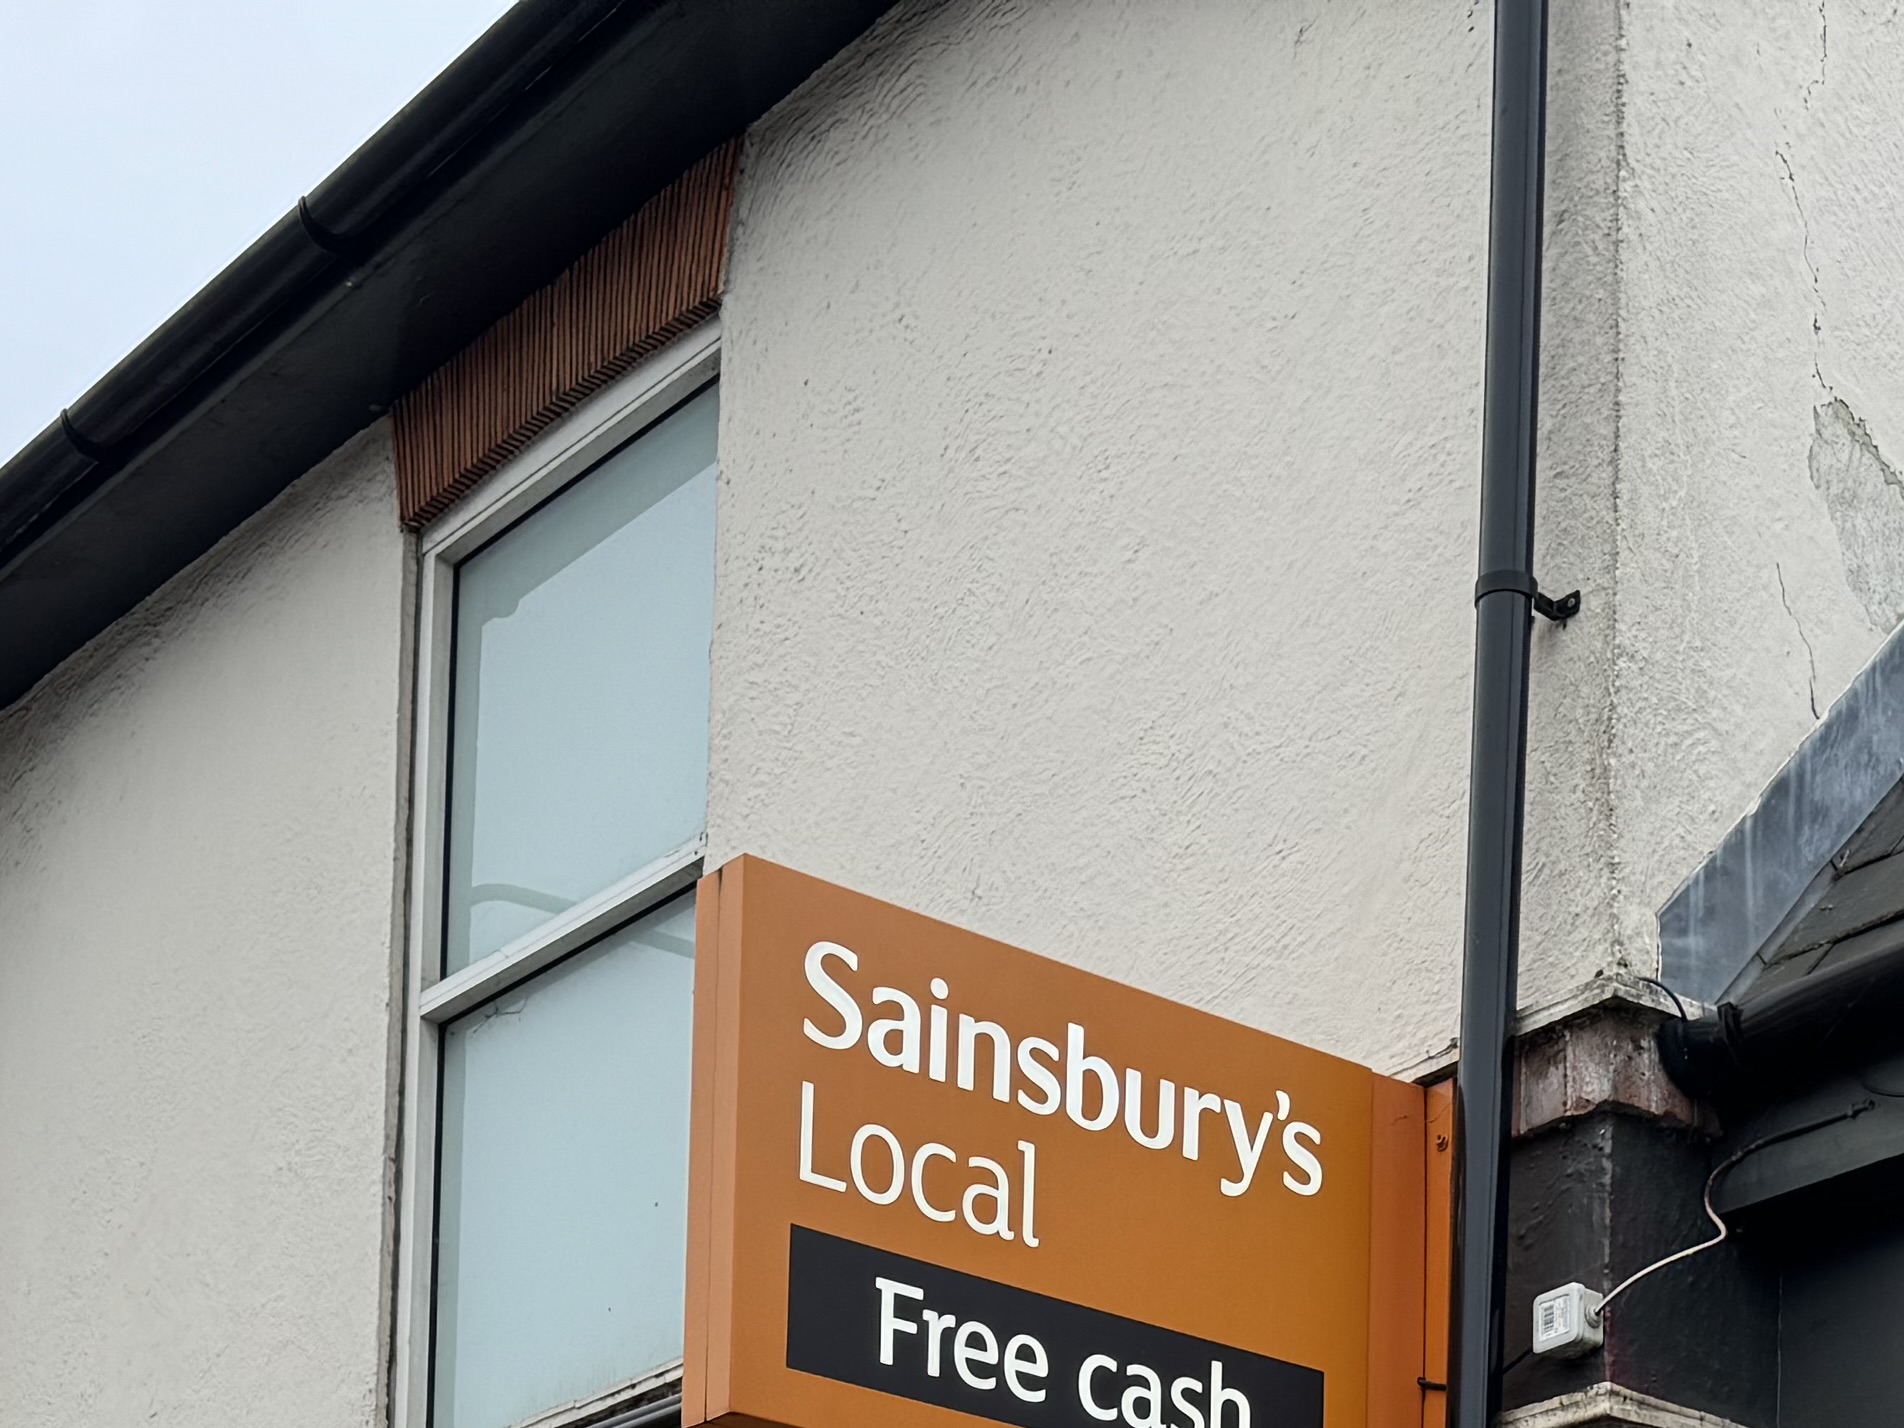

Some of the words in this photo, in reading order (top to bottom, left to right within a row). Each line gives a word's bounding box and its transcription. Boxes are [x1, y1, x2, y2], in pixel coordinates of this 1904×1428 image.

[802, 940, 1323, 1198] Sainsbury's
[799, 1081, 1039, 1247] Local
[875, 1276, 1049, 1403] Free
